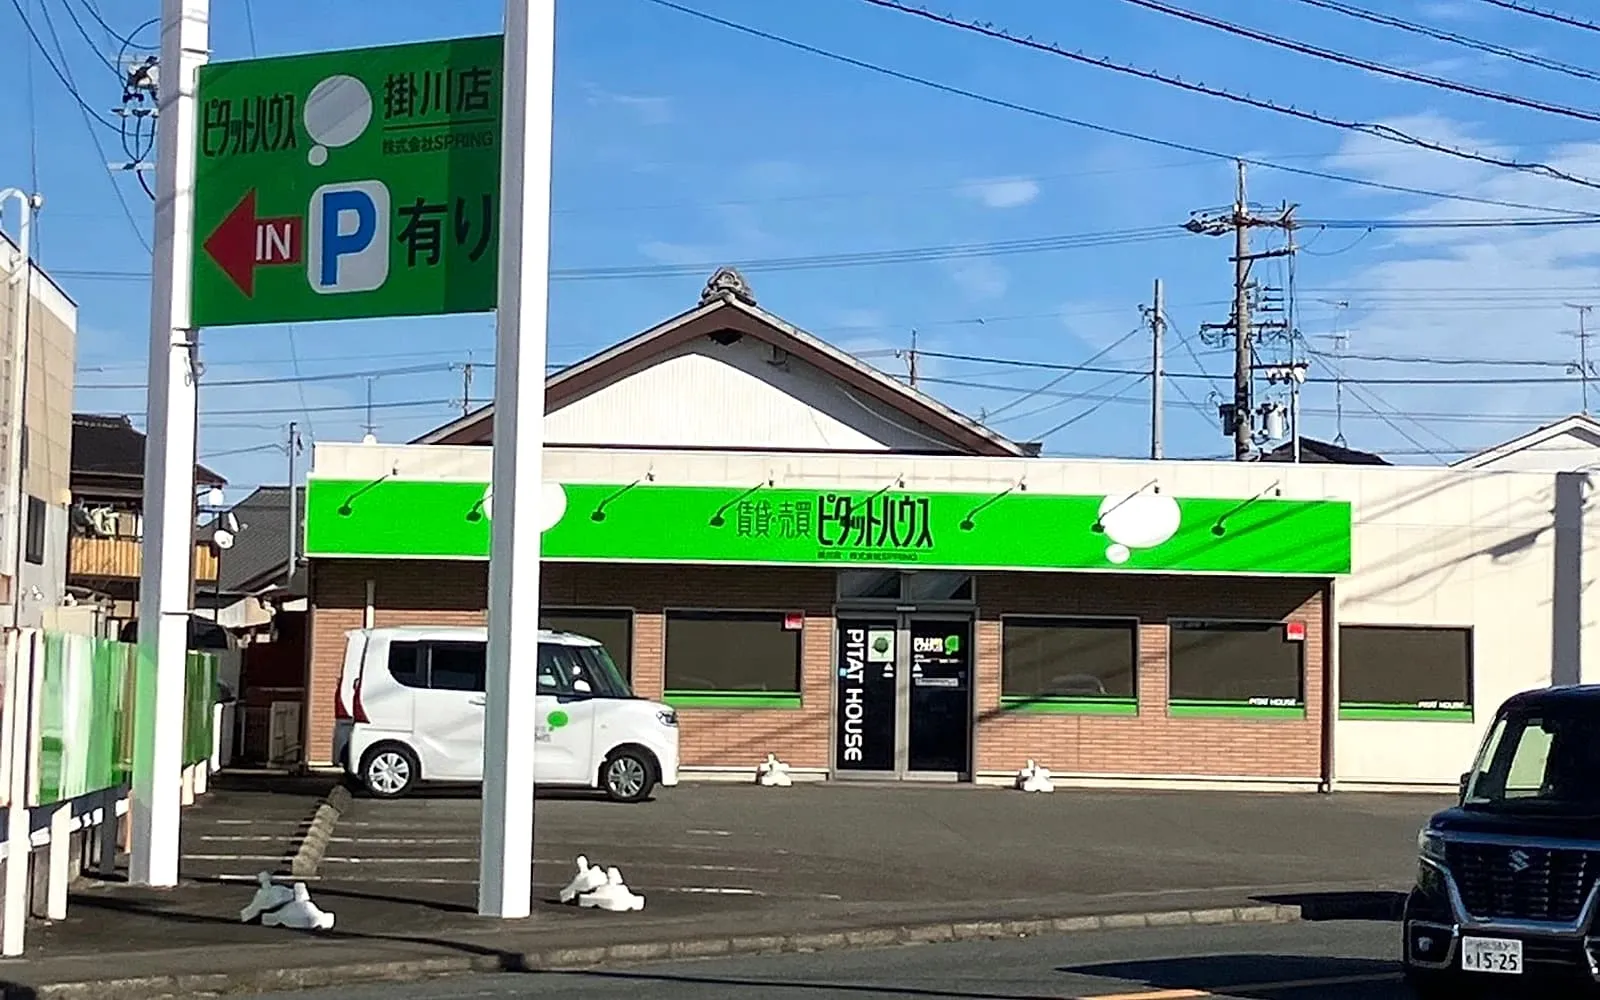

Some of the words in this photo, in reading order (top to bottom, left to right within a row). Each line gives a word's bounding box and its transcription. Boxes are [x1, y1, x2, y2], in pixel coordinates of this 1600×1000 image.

[383, 67, 493, 119] 掛川店
[203, 93, 297, 157] ピタットハウス
[382, 130, 494, 155] 株式会社SPRING
[255, 224, 291, 261] IN
[320, 190, 377, 286] P
[397, 193, 493, 267] 有り
[818, 494, 934, 548] ピタットハウス
[846, 629, 865, 683] PITAT
[844, 688, 864, 761] HOUSE
[1476, 952, 1518, 971] 15-25
